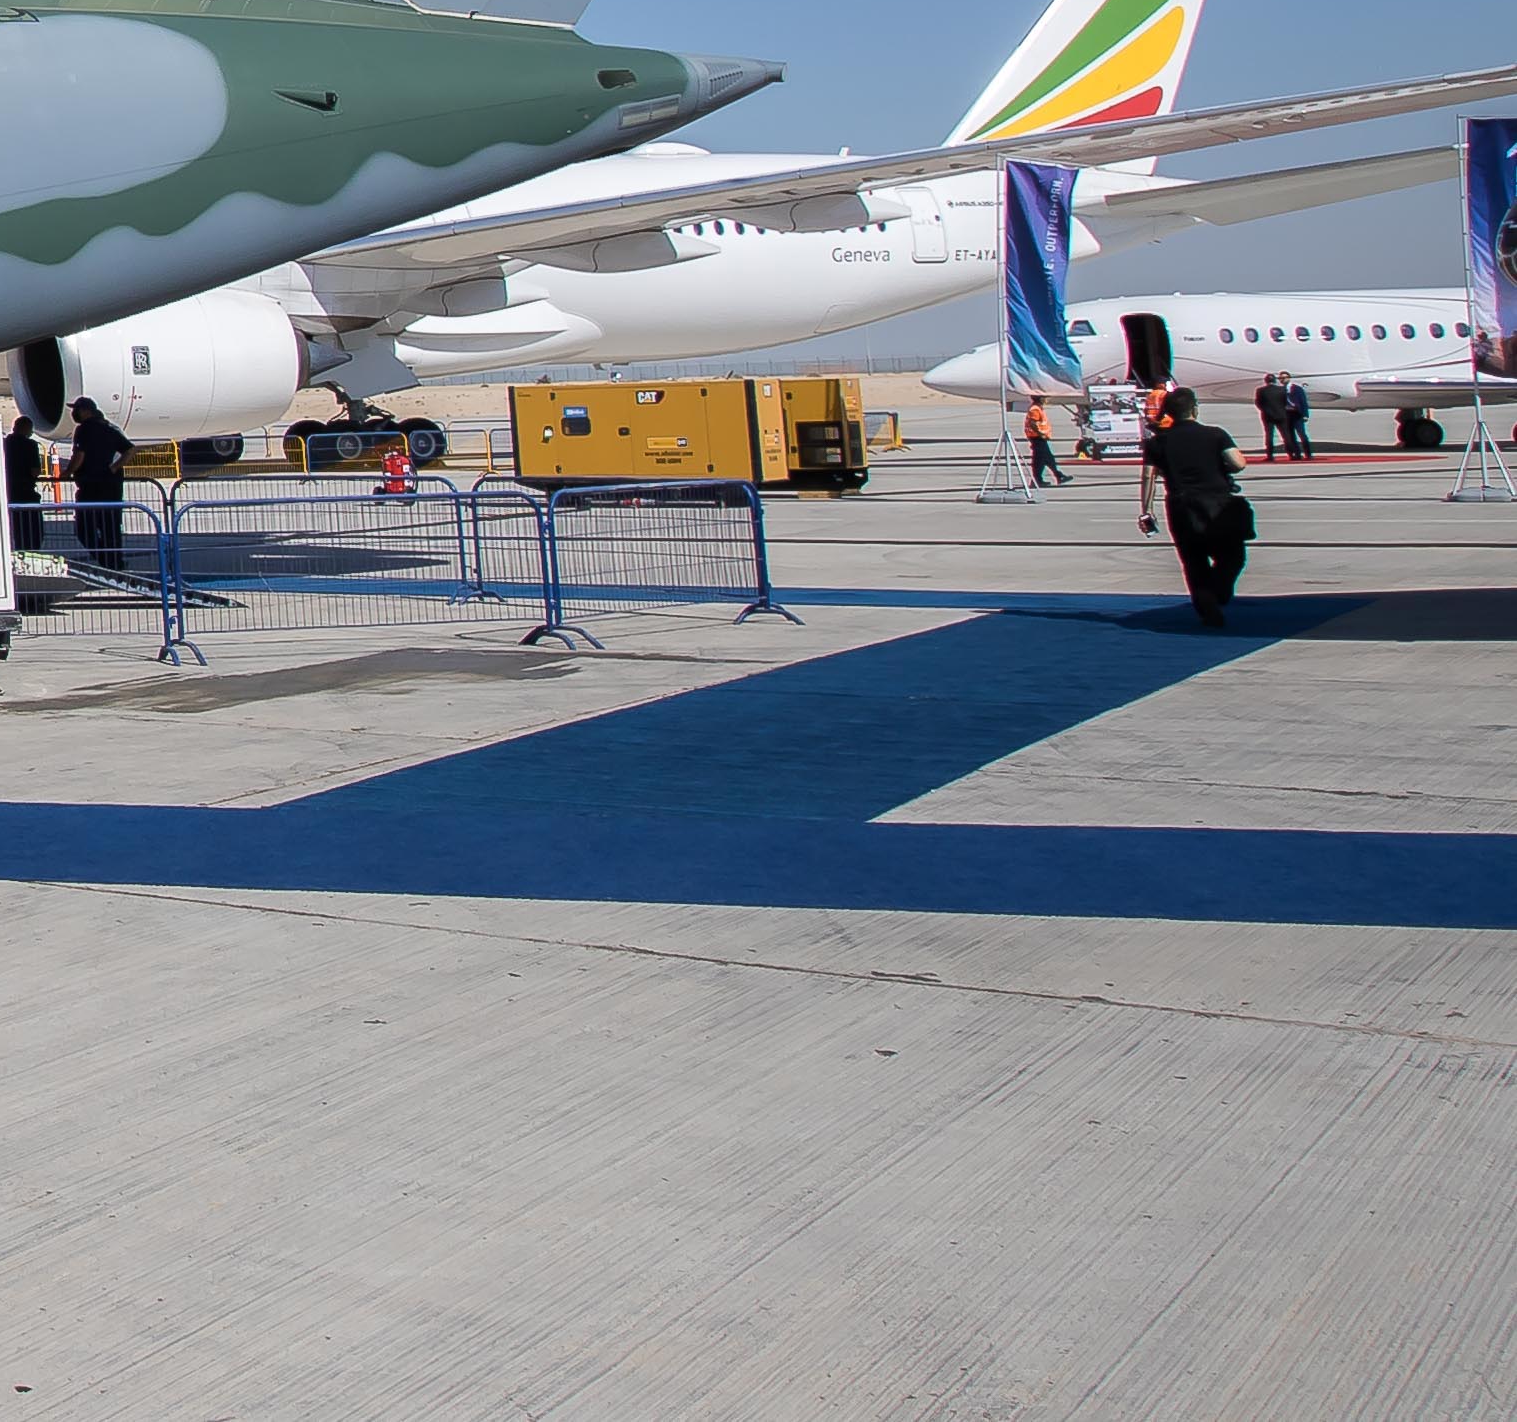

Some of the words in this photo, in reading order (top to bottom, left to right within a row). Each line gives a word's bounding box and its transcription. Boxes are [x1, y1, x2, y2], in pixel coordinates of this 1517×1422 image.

[832, 247, 891, 263] Geneva
[955, 249, 997, 261] ET-AYA
[638, 391, 658, 403] CAT
